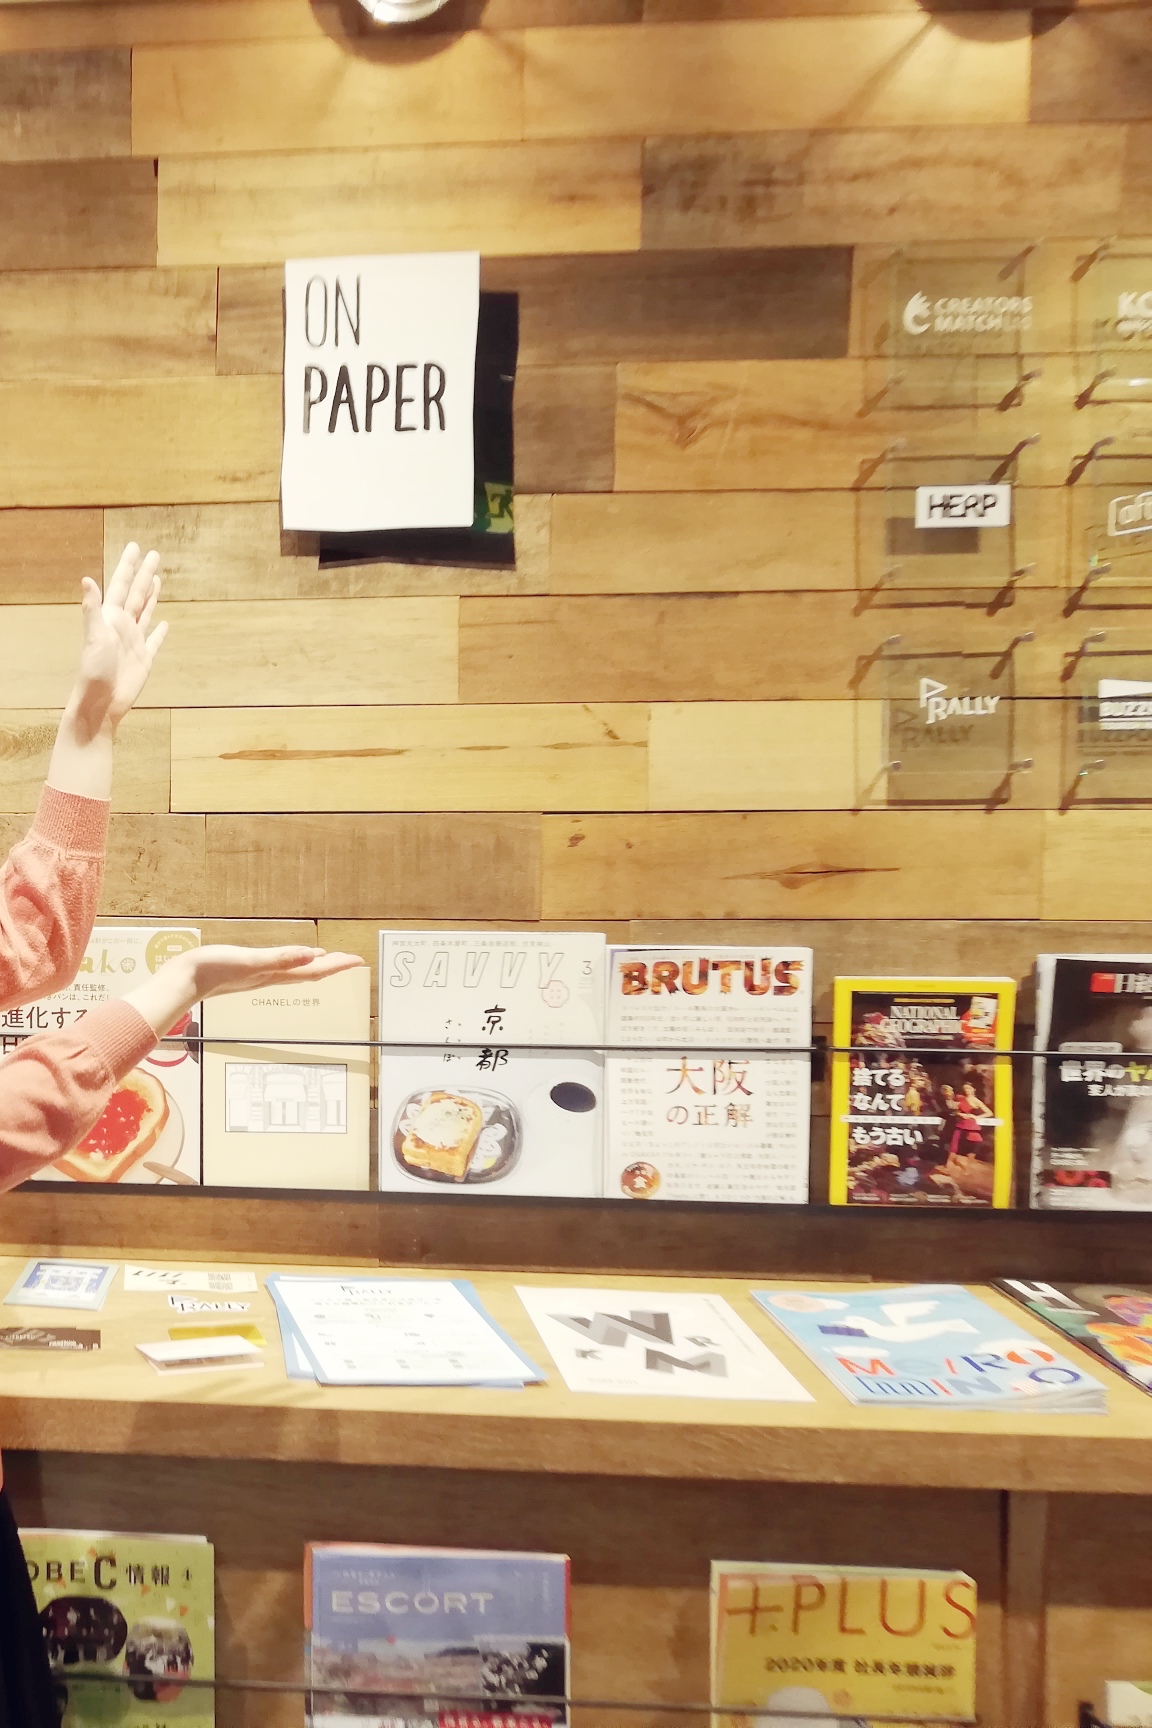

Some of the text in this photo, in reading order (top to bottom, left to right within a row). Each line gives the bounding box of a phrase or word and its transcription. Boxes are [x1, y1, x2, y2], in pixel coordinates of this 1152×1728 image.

[304, 272, 361, 347] ON
[302, 362, 447, 434] PAPER
[927, 493, 998, 519] HERP
[925, 695, 1001, 724] RALLY
[389, 951, 565, 990] SAVVY
[618, 957, 806, 996] BRUTUS
[665, 1055, 754, 1096] 大阪
[852, 1067, 907, 1087] 捨てる
[852, 1092, 906, 1112] なんて
[851, 1126, 924, 1146] もう古い
[331, 1590, 494, 1615] ESCORT
